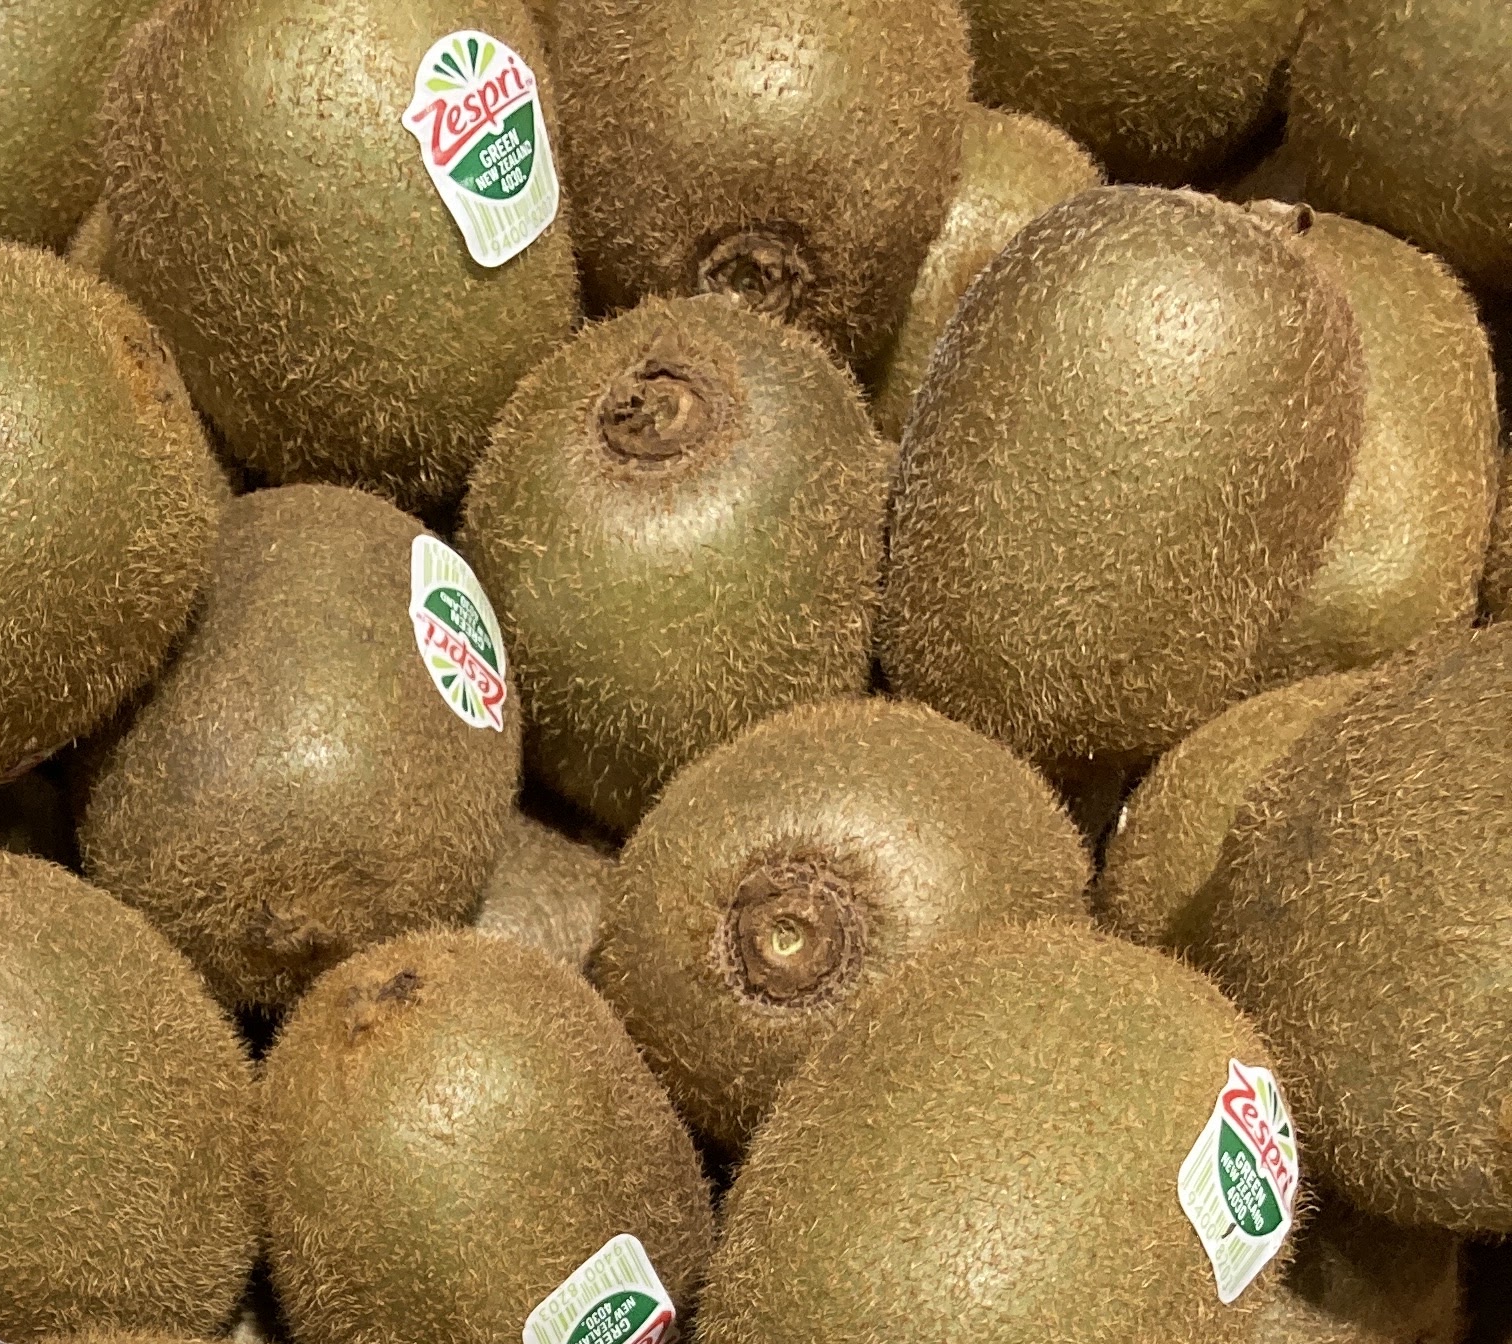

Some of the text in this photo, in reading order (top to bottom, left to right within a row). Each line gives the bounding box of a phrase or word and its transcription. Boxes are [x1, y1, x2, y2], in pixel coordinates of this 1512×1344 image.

[411, 56, 530, 167] Zespri
[479, 127, 520, 169] GREEN
[1222, 1063, 1294, 1214] Zespri
[1221, 1151, 1265, 1231] NEW ZEALAND
[1235, 1151, 1267, 1209] GREEN
[611, 1295, 636, 1321] NEW
